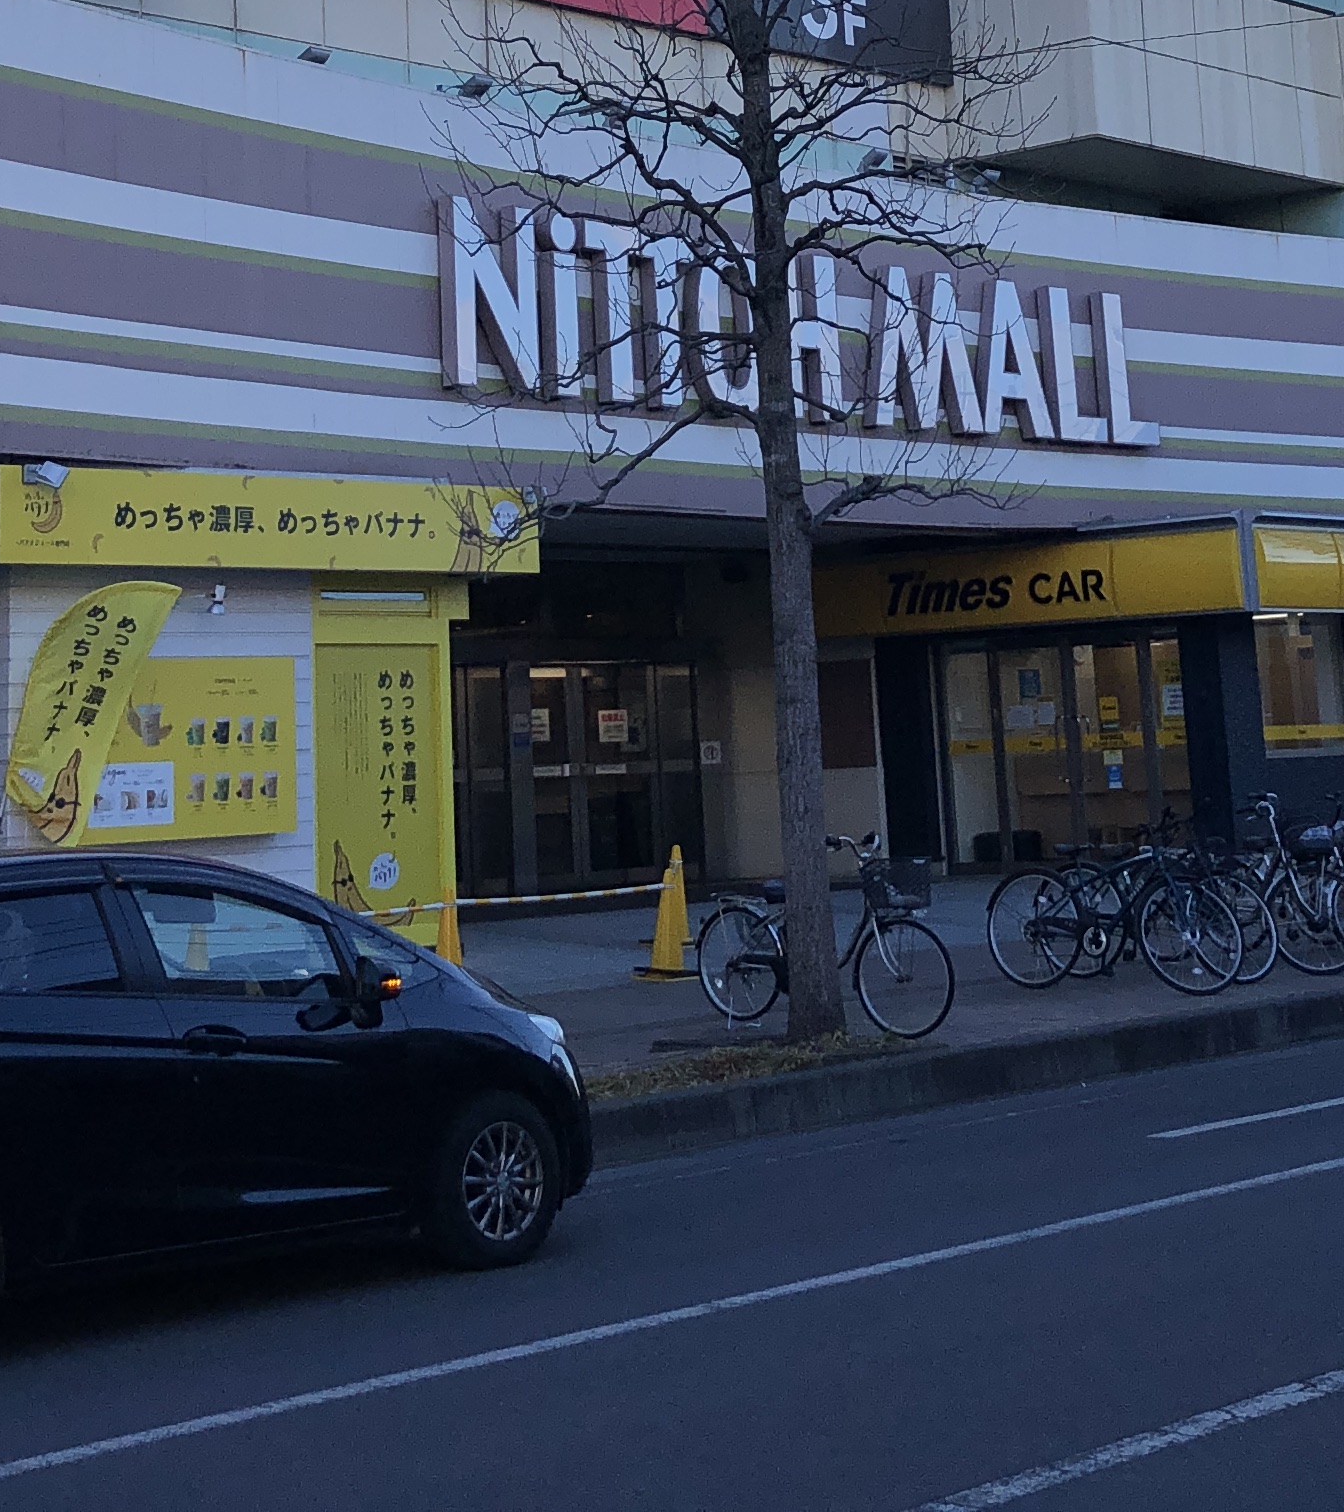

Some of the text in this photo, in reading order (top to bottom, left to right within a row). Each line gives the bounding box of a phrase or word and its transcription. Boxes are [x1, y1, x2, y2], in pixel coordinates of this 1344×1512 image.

[864, 265, 1161, 448] MALL
[885, 568, 1107, 617] Times CAR
